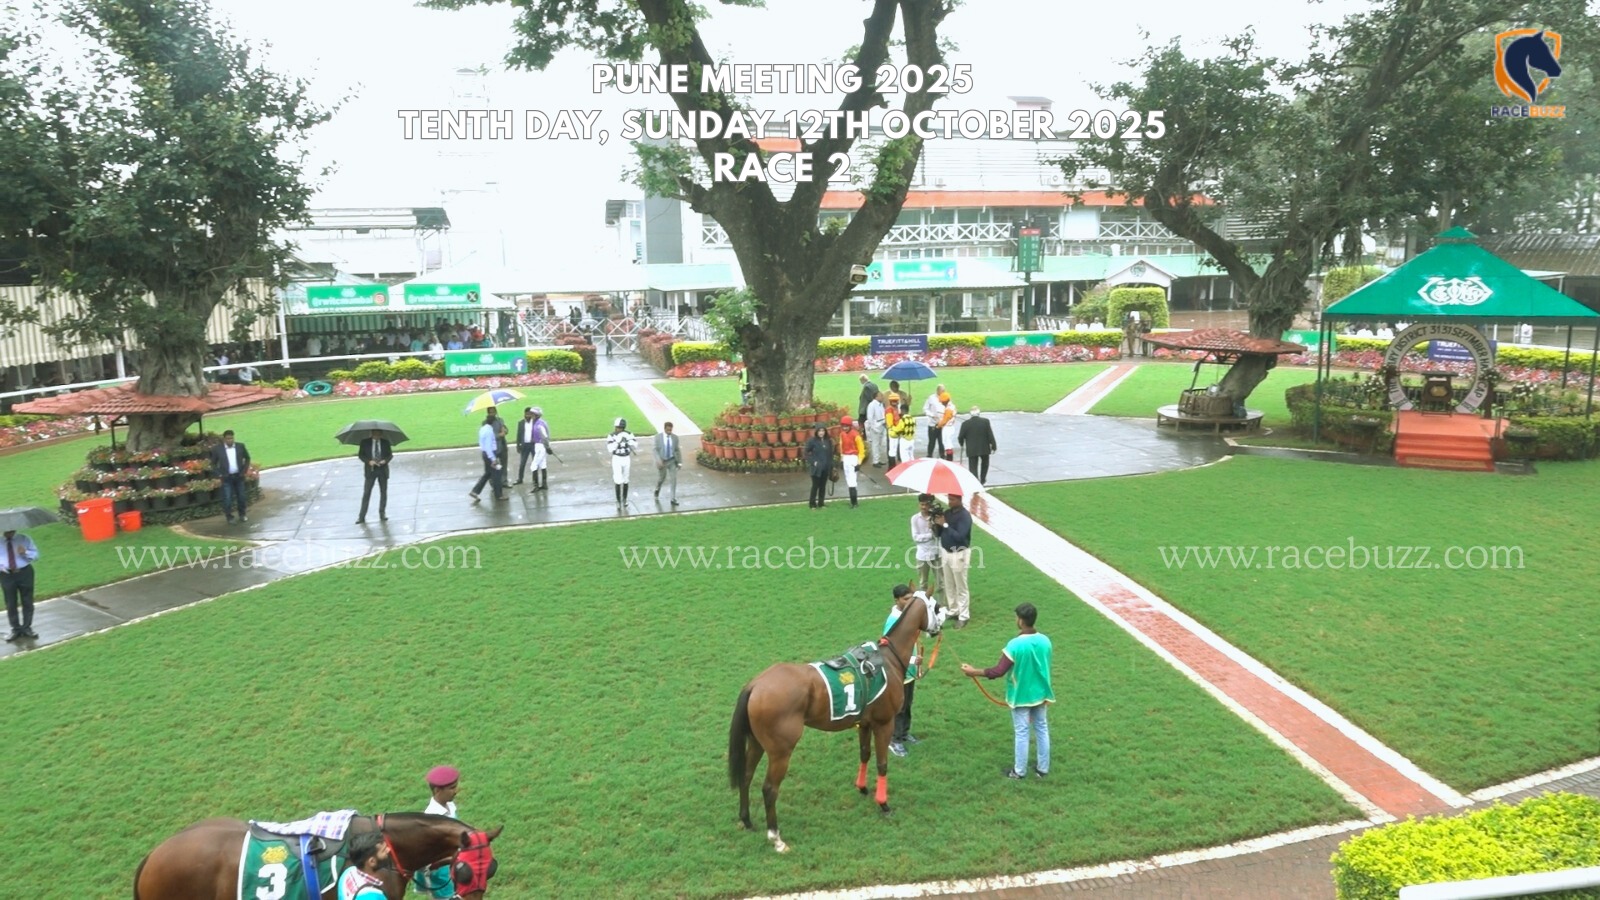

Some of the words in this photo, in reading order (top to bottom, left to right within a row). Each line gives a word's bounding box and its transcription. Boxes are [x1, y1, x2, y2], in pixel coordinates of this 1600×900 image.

[1395, 326, 1426, 351] DISTRICT
[449, 361, 511, 373] @rwitcmumbai
[844, 684, 857, 712] 1
[256, 863, 288, 900] 3
